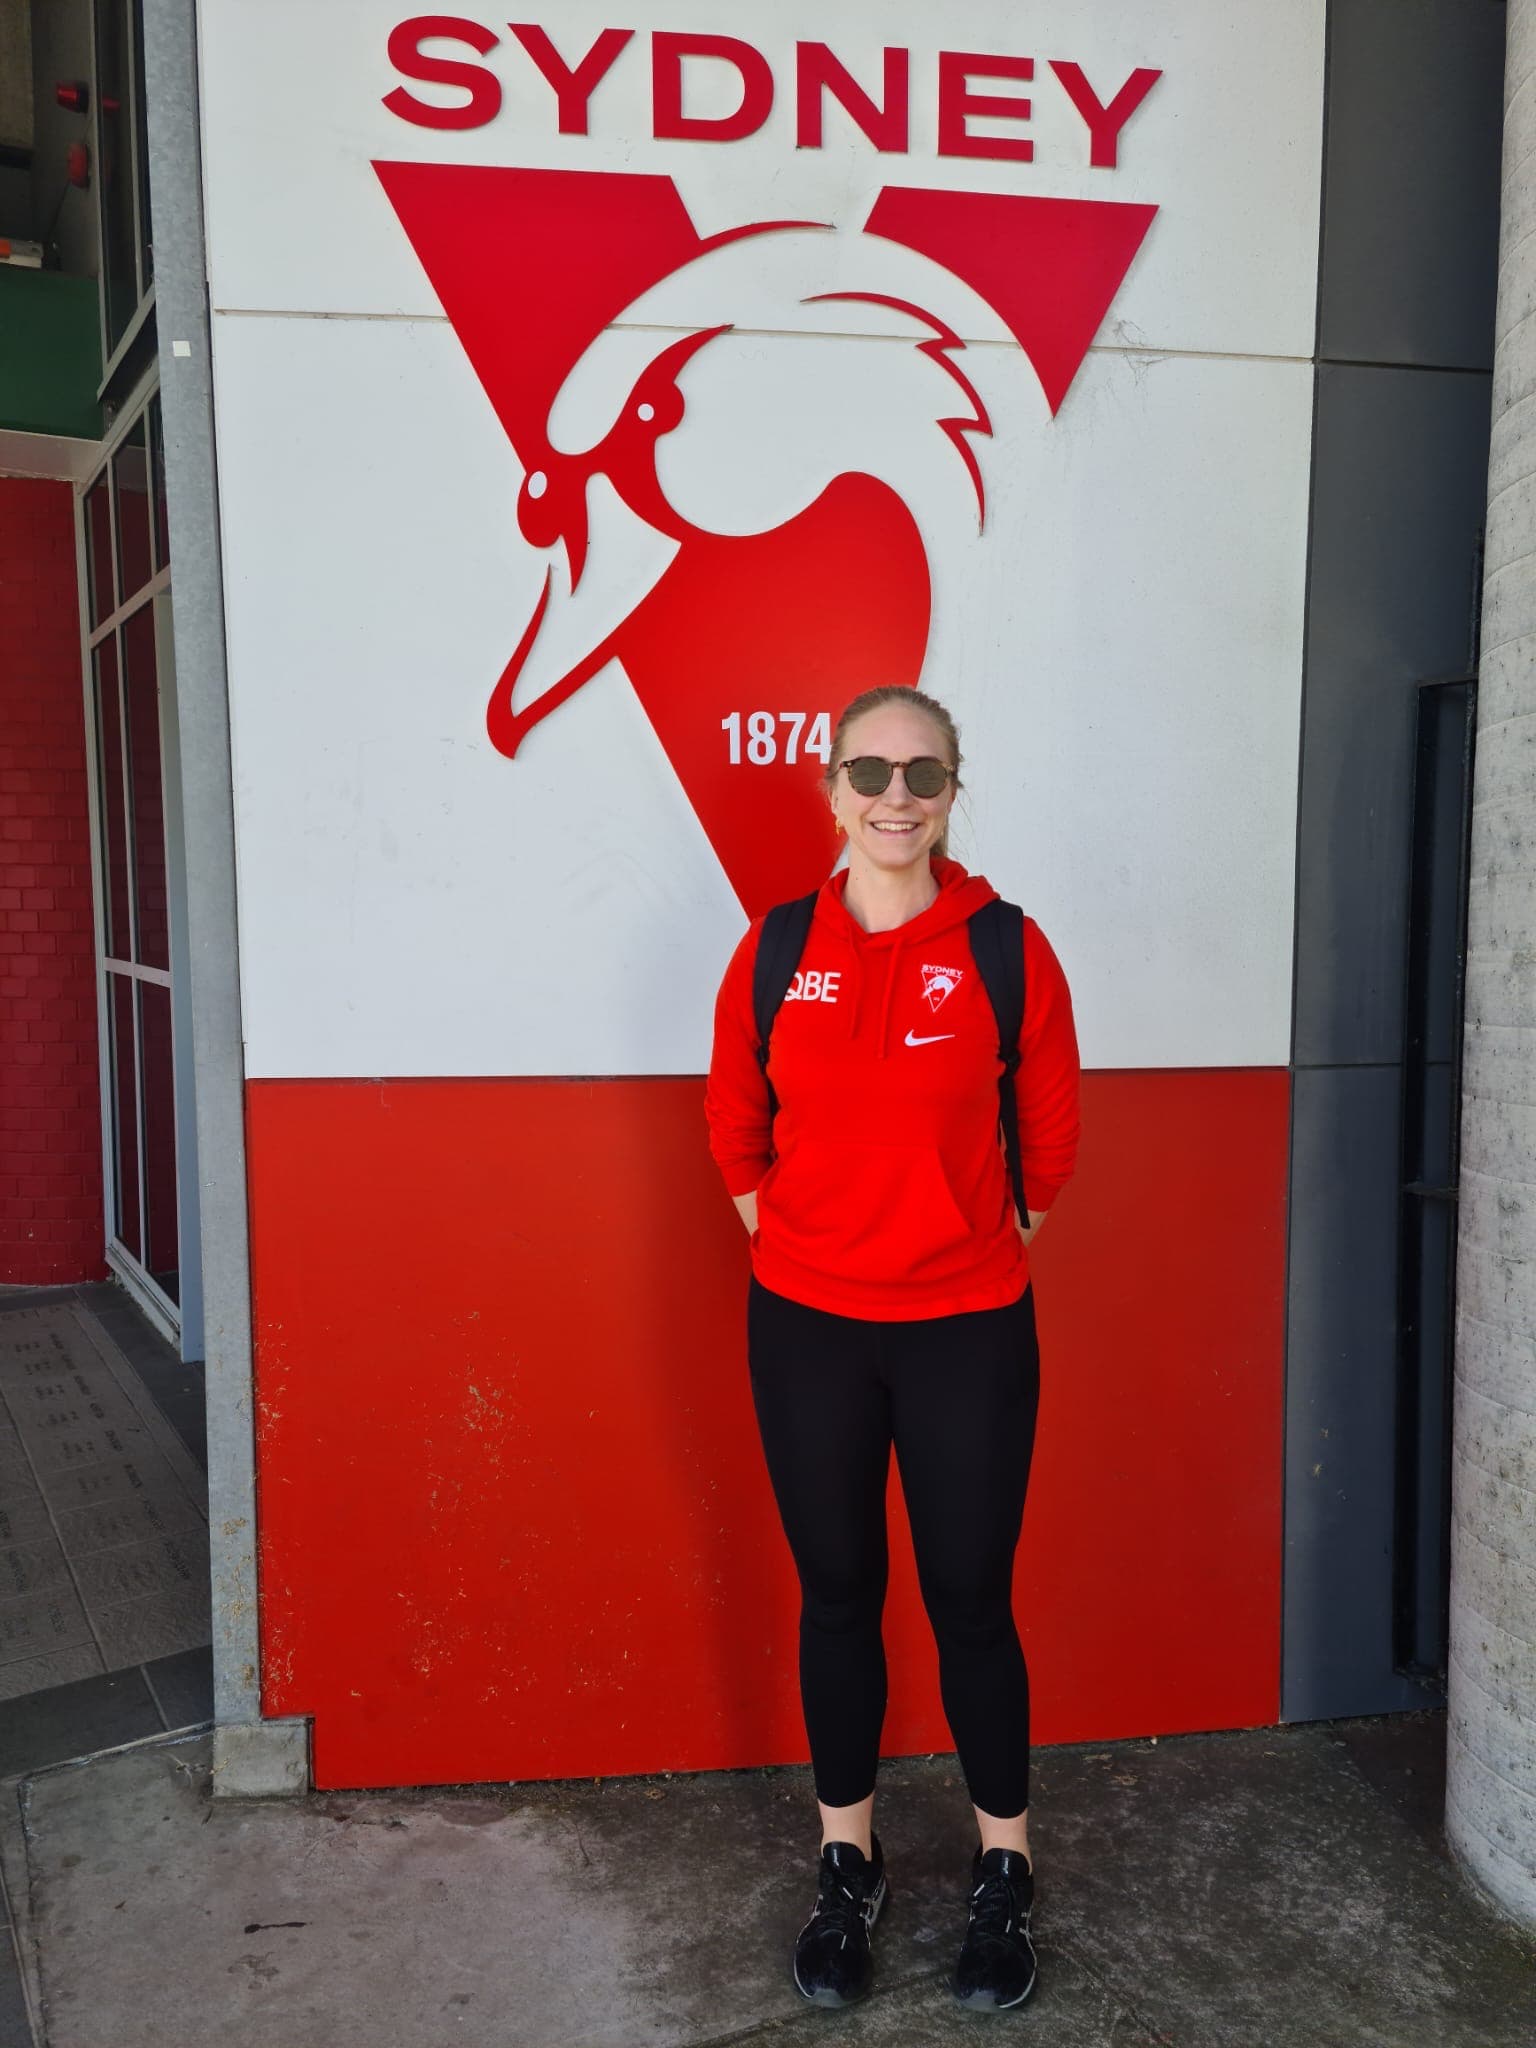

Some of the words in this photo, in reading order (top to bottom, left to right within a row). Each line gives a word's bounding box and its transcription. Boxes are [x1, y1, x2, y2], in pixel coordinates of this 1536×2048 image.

[381, 15, 1163, 169] SYDNEY
[721, 711, 832, 766] 1874
[921, 964, 963, 977] SYDNEY
